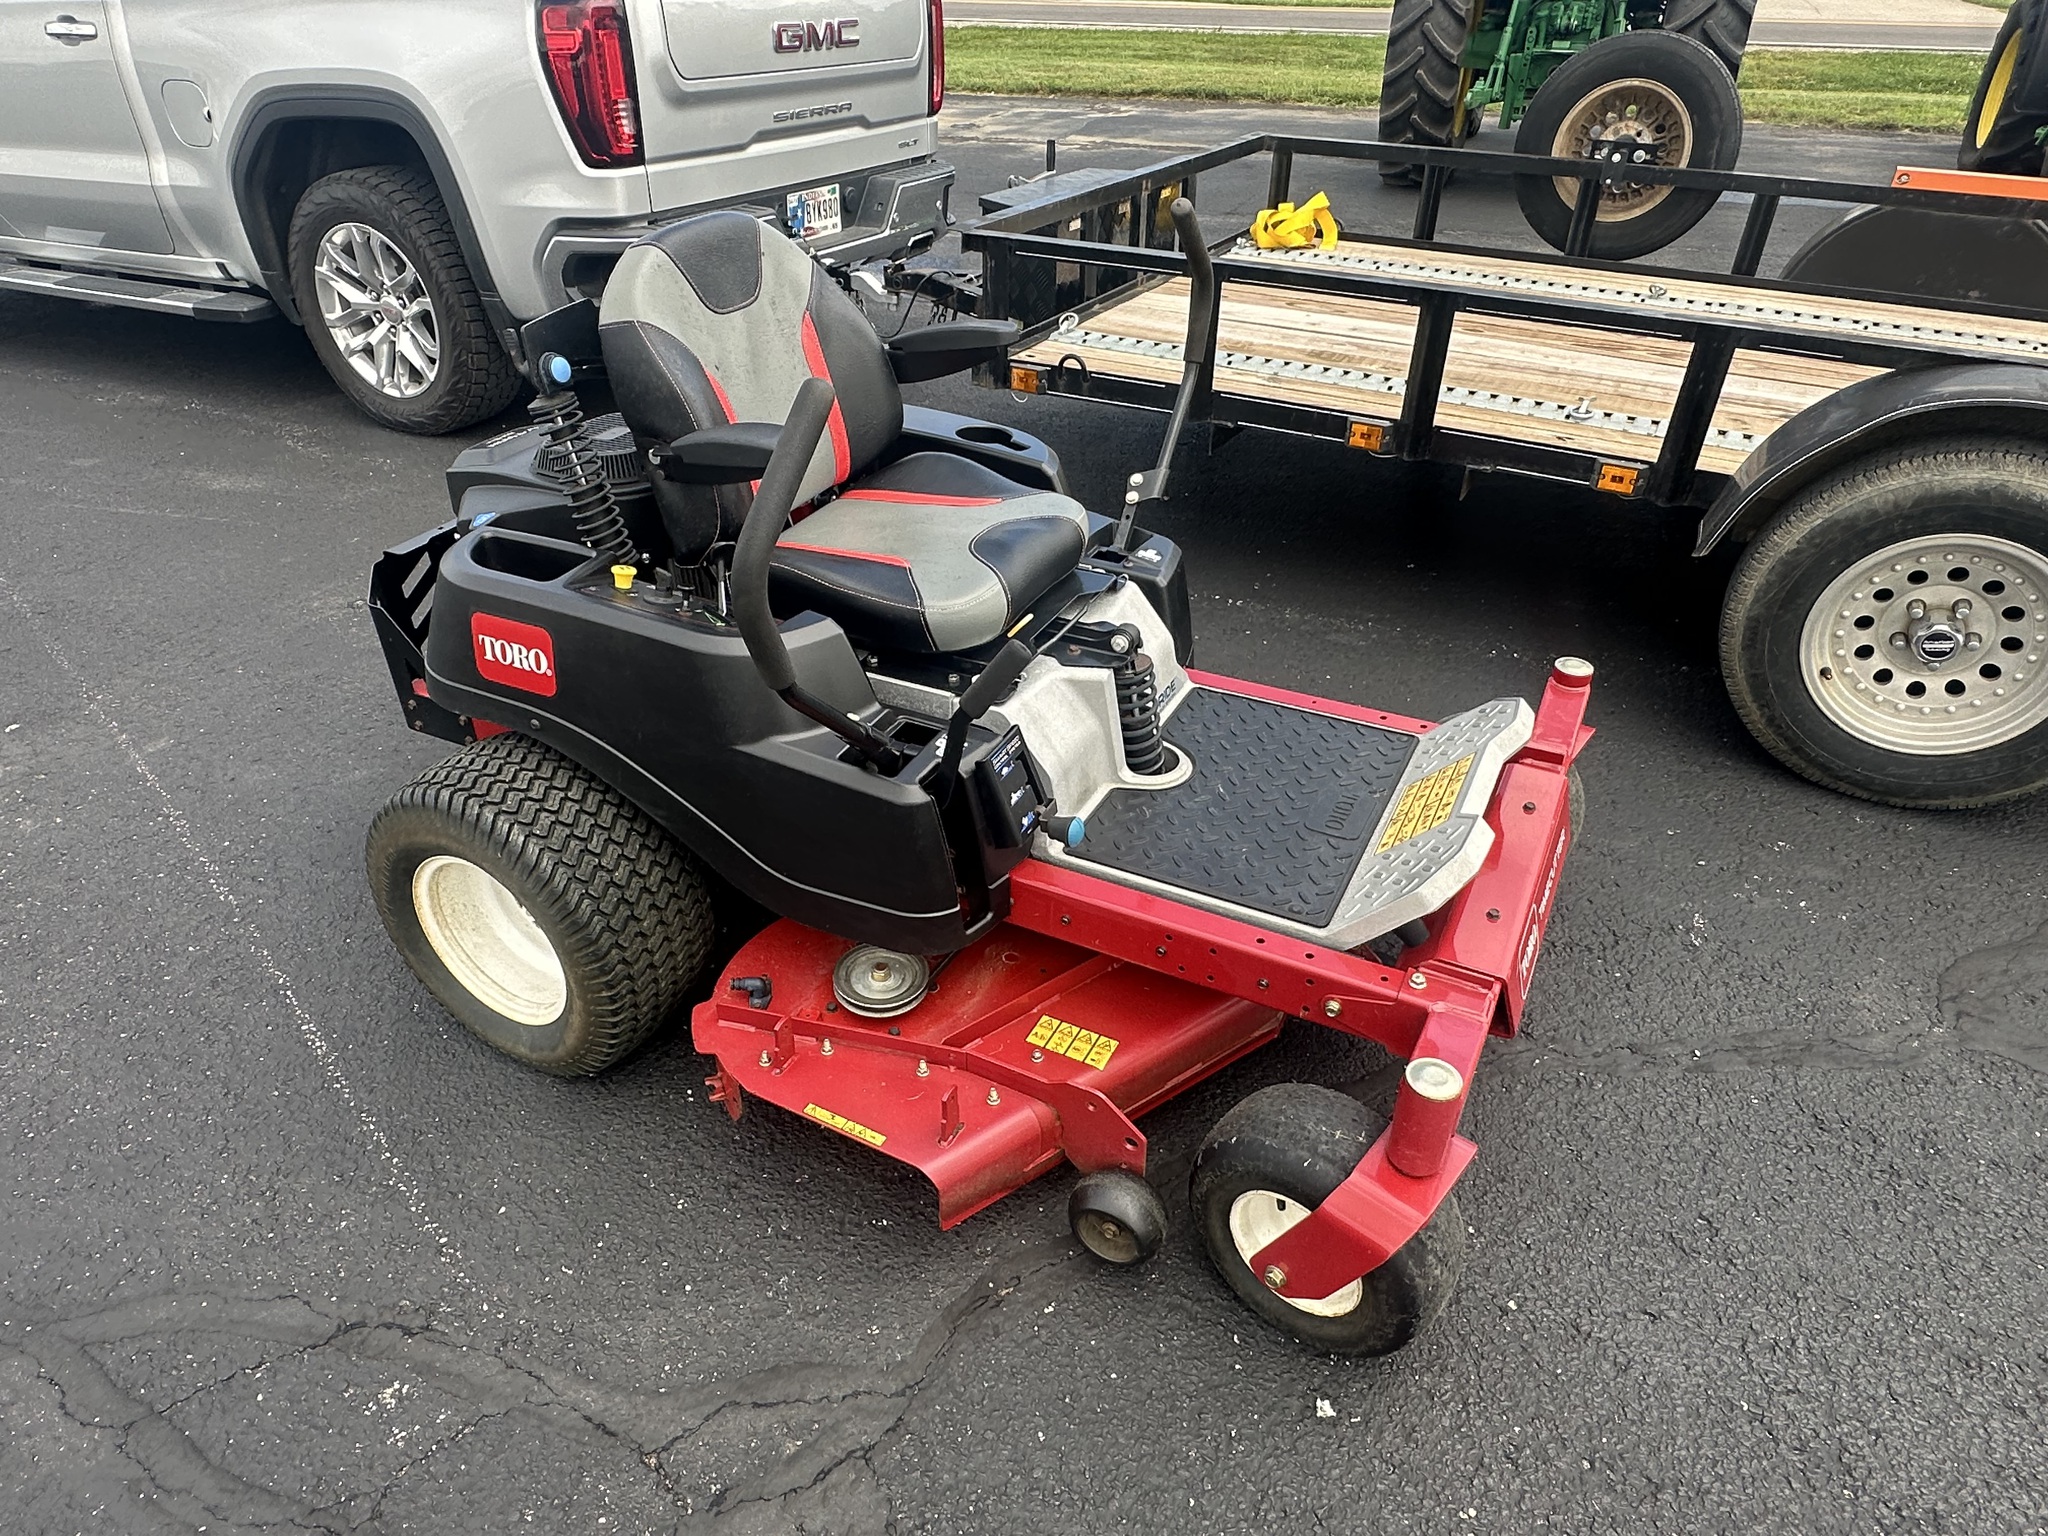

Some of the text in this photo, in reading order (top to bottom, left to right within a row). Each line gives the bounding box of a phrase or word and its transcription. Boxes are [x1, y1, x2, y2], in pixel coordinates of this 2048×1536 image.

[772, 17, 860, 53] GMC
[773, 101, 853, 123] SIERRA
[478, 634, 551, 676] TORO
